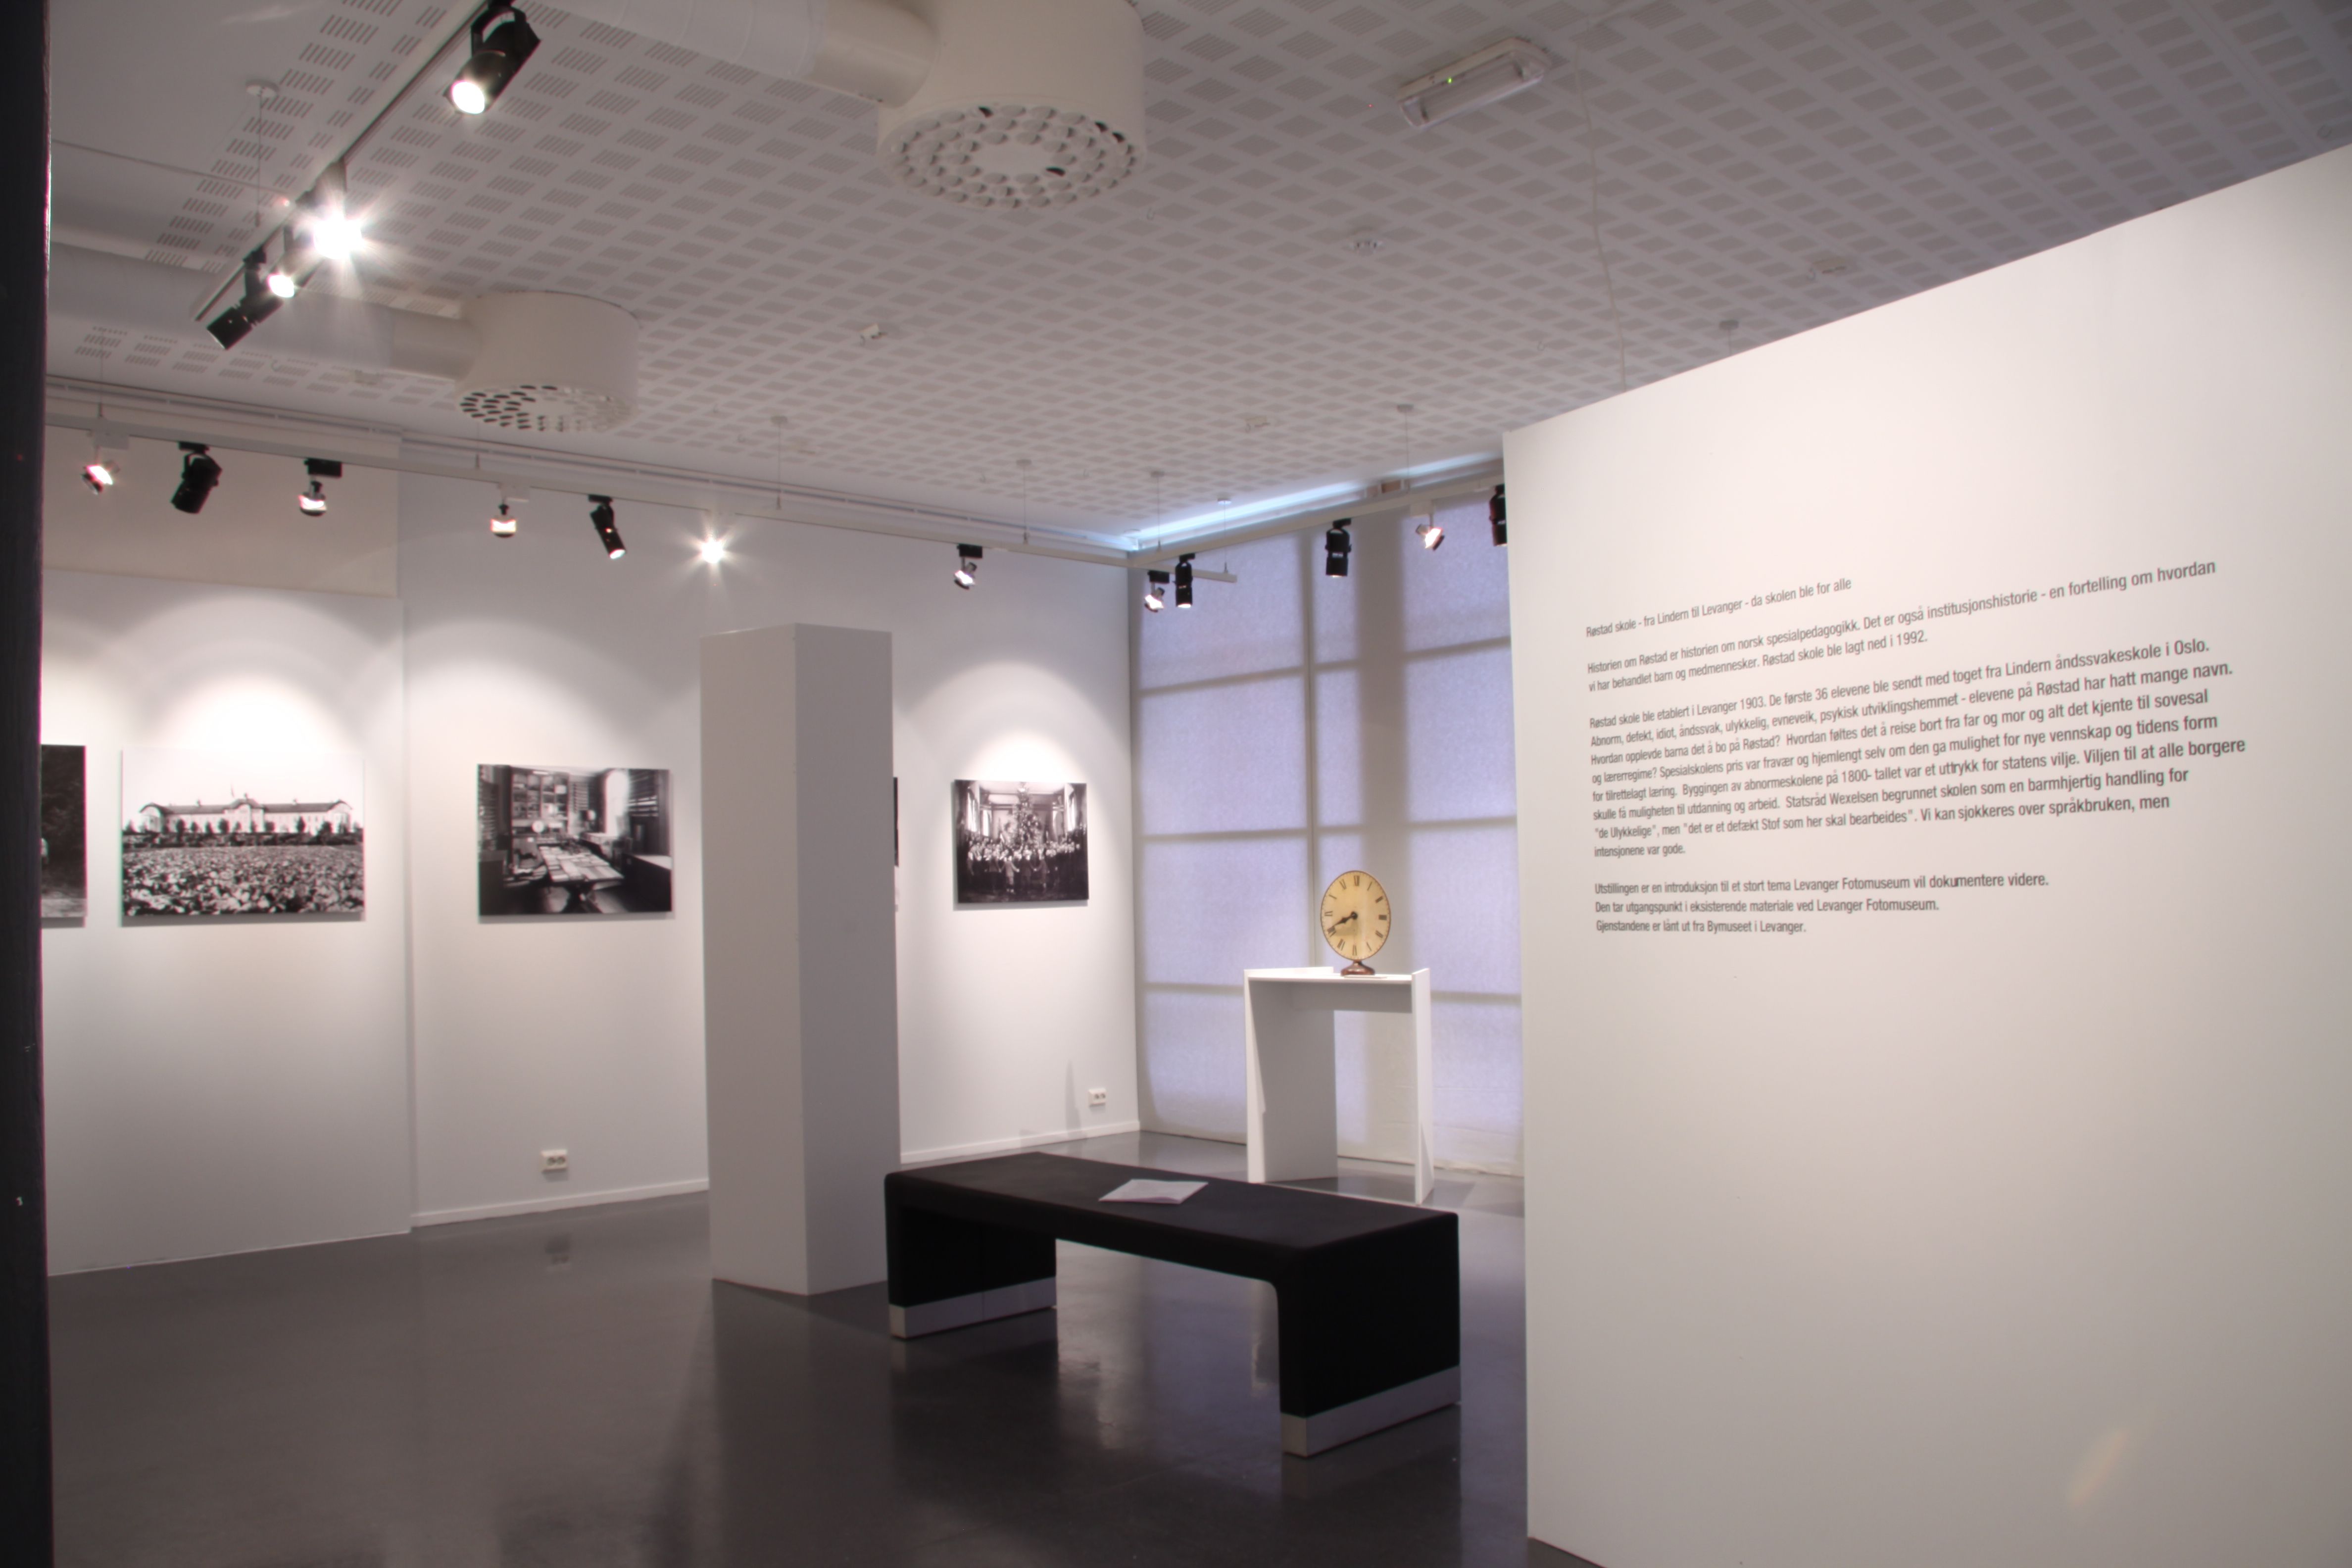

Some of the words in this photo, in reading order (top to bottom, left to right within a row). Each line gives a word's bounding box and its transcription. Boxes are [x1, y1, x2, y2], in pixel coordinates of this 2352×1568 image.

[1586, 622, 1613, 637] Røstad
[1615, 619, 1637, 633] skole
[1657, 610, 1689, 625] Lindern
[1702, 600, 1743, 617] Levanger
[1764, 589, 1797, 605] skolen
[1799, 585, 1814, 598] ble
[1816, 582, 1831, 595] for
[1833, 578, 1852, 592] alle
[1587, 659, 1622, 674] Historien
[1639, 650, 1668, 666] Røstad
[1680, 643, 1719, 659] historien
[1738, 635, 1764, 650] norsk
[1766, 619, 1861, 647] spesialpedagogikk.
[1863, 615, 1881, 630] Det
[1898, 605, 1924, 626] også
[1927, 589, 2038, 619] institusjonshistorie
[2068, 576, 2127, 596] fortelling
[2157, 561, 2215, 582] hvordan
[1589, 715, 1617, 729] Røstad
[1618, 712, 1640, 725] skole
[1657, 706, 1690, 721] etablert
[1697, 701, 1738, 716] Levanger
[1740, 695, 1767, 710] 1903.
[1783, 690, 1813, 705] første
[1830, 684, 1870, 699] elevene
[1873, 680, 1890, 693] ble
[1892, 675, 1923, 691] sendt
[1925, 671, 1950, 687] med
[1952, 667, 1983, 685] toget
[1985, 665, 2002, 679] fra
[2005, 659, 2052, 677] Lindern
[2055, 644, 2161, 670] åndssvakeskole
[2174, 638, 2209, 655] Oslo.
[1612, 672, 1652, 689] behandlet
[1654, 671, 1673, 683] barn
[1688, 657, 1760, 678] medmennesker.
[1762, 650, 1795, 667] Røstad
[1798, 646, 1824, 661] skole
[1826, 643, 1843, 657] ble
[1845, 639, 1865, 656] lagt
[1867, 635, 1887, 651] ned
[1896, 629, 1928, 646] 1992.
[1590, 735, 1624, 747] Abnorm,
[1625, 730, 1654, 743] defekt,
[1656, 727, 1677, 740] idiot,
[1679, 721, 1723, 737] åndssvak,
[1725, 716, 1769, 734] ulykkelig,
[1771, 710, 1817, 727] evneveik,
[1820, 705, 1859, 724] psykisk
[1862, 692, 1959, 717] utviklingshemmet
[1968, 688, 2014, 704] elevene
[2036, 677, 2080, 696] Røstad
[2084, 677, 2106, 691] har
[2109, 671, 2137, 688] hatt
[2140, 668, 2189, 685] mange
[2193, 663, 2233, 679] navn.
[1591, 752, 1623, 766] Hvordan
[1625, 748, 1663, 764] opplevde
[1664, 746, 1689, 758] barna
[1691, 743, 1706, 756] det
[1743, 735, 1781, 750] Røstad?
[1786, 731, 1827, 746] Hvordan
[1829, 728, 1858, 742] føltes
[1861, 725, 1878, 738] det
[1890, 721, 1916, 735] reise
[1919, 717, 1943, 733] bort
[1944, 716, 1960, 730] fra
[1963, 713, 1980, 727] far
[2001, 710, 2026, 724] mor
[2048, 704, 2064, 719] alt
[2067, 701, 2089, 717] det
[2092, 697, 2133, 717] kjente
[2136, 694, 2150, 710] til
[2154, 688, 2208, 708] sovesal
[1603, 767, 1658, 783] lærerregime?
[1659, 762, 1724, 780] Spesialskolens
[1726, 759, 1744, 775] pris
[1745, 760, 1761, 770] var
[1763, 756, 1795, 769] fravær
[1811, 748, 1862, 767] hjemlengt
[1864, 745, 1886, 760] selv
[1909, 742, 1930, 756] den
[1949, 734, 2001, 752] mulighet
[2003, 733, 2021, 746] for
[2023, 732, 2046, 747] nye
[2049, 725, 2112, 742] vennskap
[2135, 719, 2179, 735] tidens
[2183, 715, 2218, 731] form
[1605, 787, 1647, 801] tilrettelagt
[1648, 785, 1678, 799] læring.
[1682, 782, 1729, 797] Byggingen
[1744, 774, 1823, 791] abnormeskolene
[1874, 766, 1902, 781] tallet
[1904, 767, 1922, 778] var
[1981, 757, 1999, 772] for
[2002, 755, 2047, 770] statens
[2050, 751, 2080, 769] vilje.
[2083, 748, 2120, 766] Viljen
[2123, 745, 2137, 761] til
[2158, 742, 2184, 758] alle
[2188, 740, 2246, 758] borgere
[1593, 808, 1617, 821] skulle
[1628, 805, 1675, 820] muligheten
[1687, 801, 1732, 815] utdanning
[1748, 797, 1780, 811] arbeid.
[1785, 792, 1827, 808] Statsråd
[1829, 790, 1879, 805] Wexelsen
[1881, 785, 1938, 804] begrunnet
[1940, 783, 1977, 798] skolen
[1980, 783, 2006, 795] som
[2028, 773, 2102, 792] barmhjertig
[2105, 770, 2165, 787] handling
[2168, 767, 2189, 783] for
[1726, 819, 1760, 833] defækt
[1761, 817, 1781, 831] Stof
[1782, 818, 1804, 830] som
[1806, 815, 1823, 828] her
[1825, 813, 1847, 827] skal
[1934, 807, 1956, 821] kan
[1958, 804, 2015, 822] sjokkeres
[2018, 803, 2046, 816] over
[2049, 796, 2135, 817] språkbruken,
[2139, 796, 2170, 810] men
[1594, 845, 1645, 859] intensjonene
[1662, 842, 1686, 857] gode.
[1594, 882, 1639, 896] Utstillingen
[1664, 881, 1718, 895] introduksjon
[1720, 880, 1729, 892] til
[1743, 880, 1765, 892] stort
[1766, 880, 1792, 891] tema
[1793, 879, 1840, 893] Levanger
[1842, 877, 1911, 890] Fotomuseum
[1913, 875, 1926, 888] vil
[1929, 874, 2005, 888] dokumentere
[2008, 872, 2049, 886] videre.
[1625, 901, 1683, 915] utgangspunkt
[1689, 900, 1747, 913] eksisterende
[1749, 899, 1794, 912] materiale
[1796, 899, 1814, 912] ved
[1816, 899, 1864, 914] Levanger
[1866, 898, 1939, 911] Fotomuseum.
[1596, 920, 1651, 933] Gjenstandene
[1663, 918, 1680, 932] lånt
[1692, 920, 1705, 932] fra
[1707, 920, 1753, 935] Bymuseet
[1760, 920, 1807, 935] Levanger.
